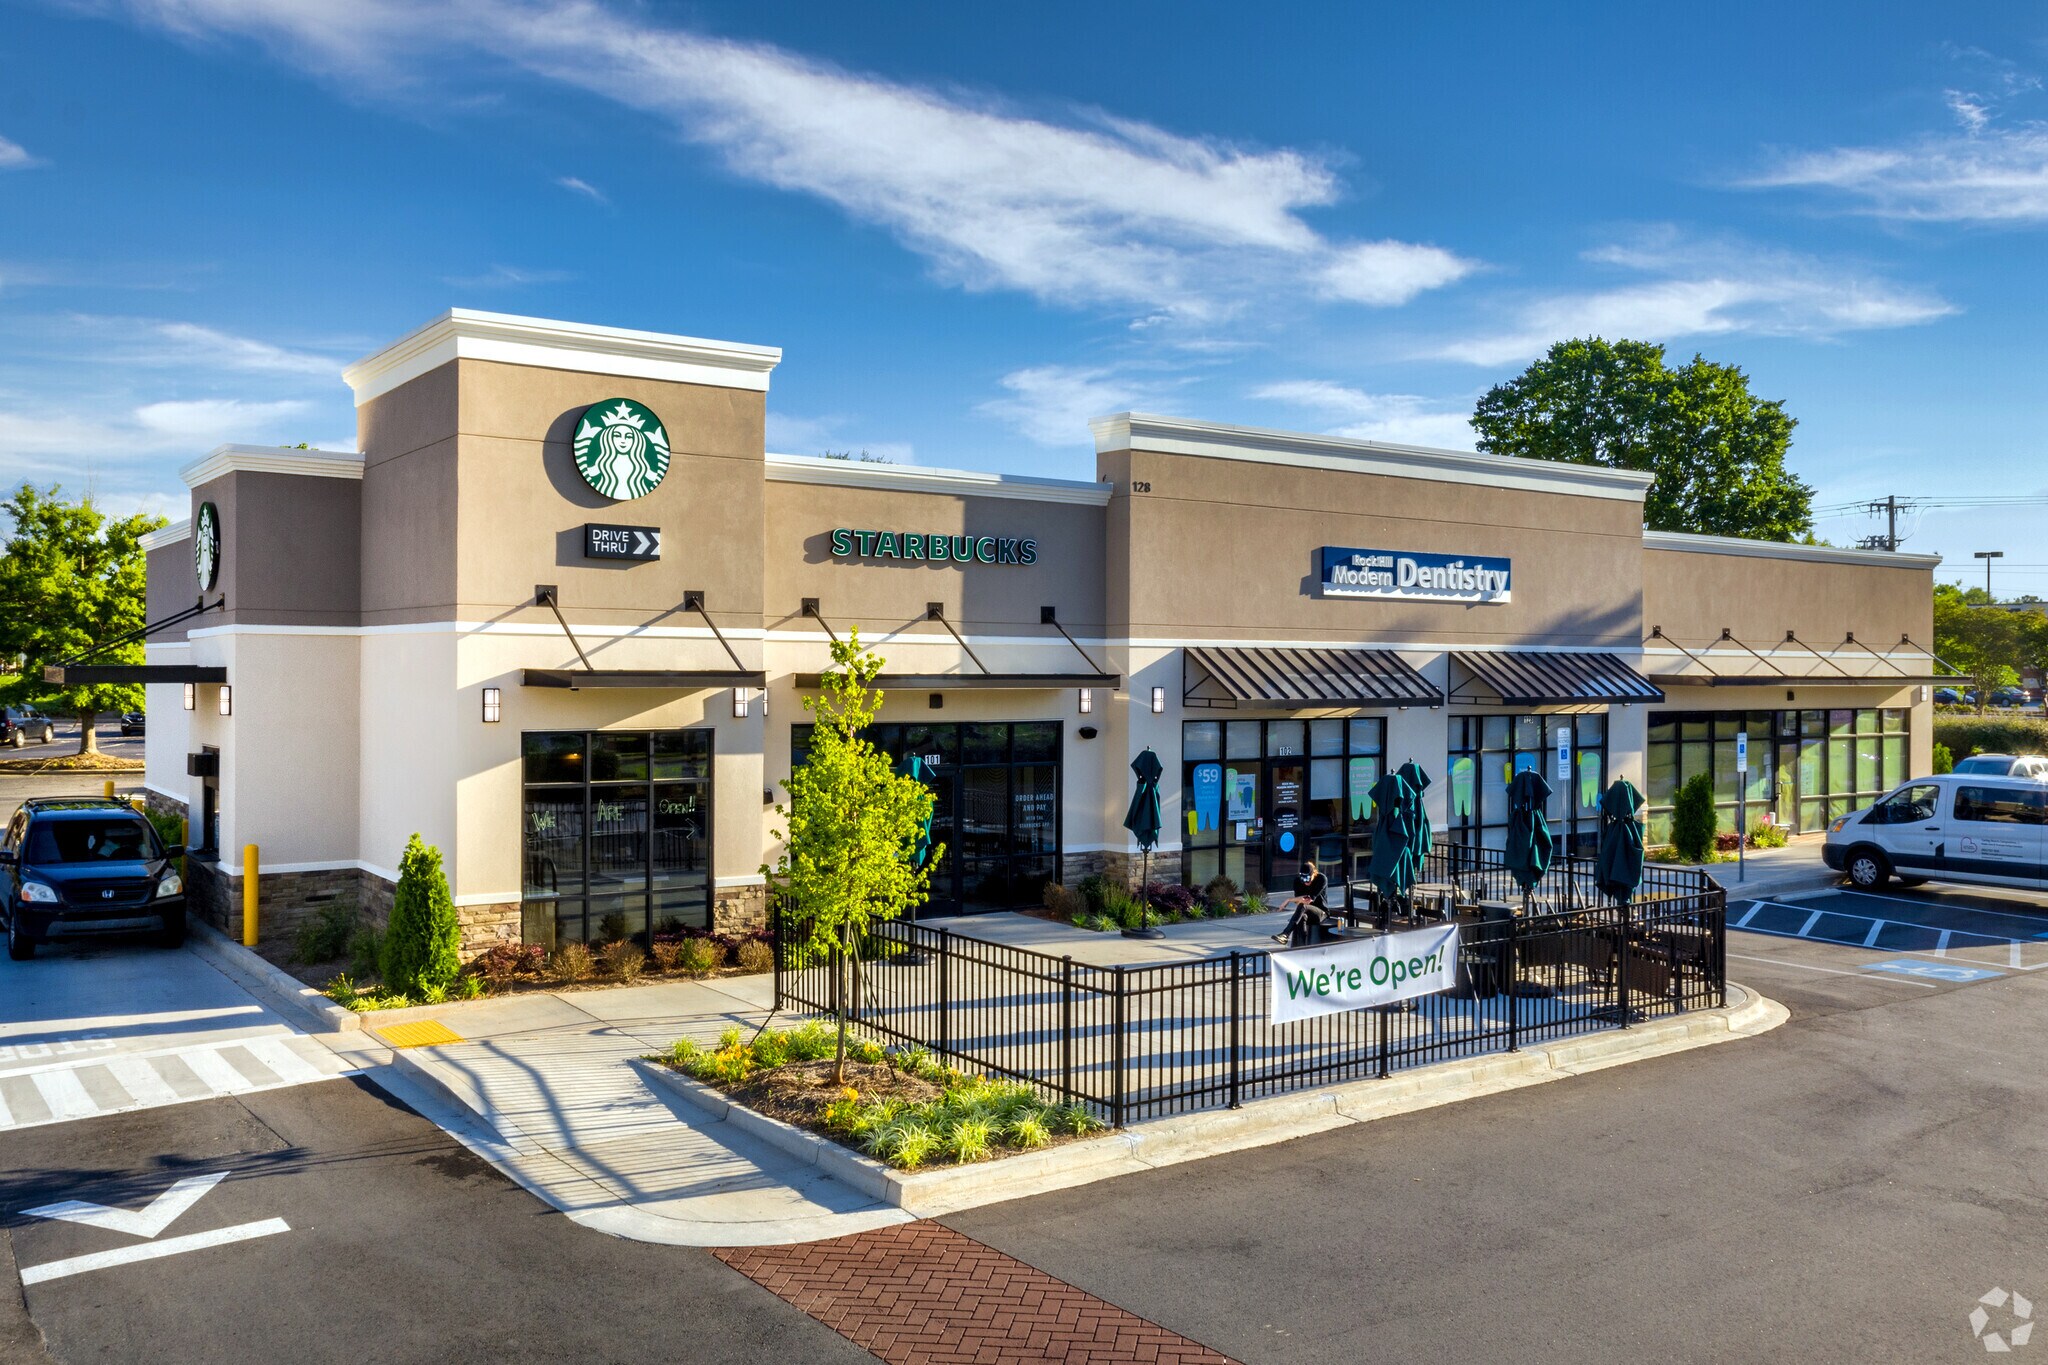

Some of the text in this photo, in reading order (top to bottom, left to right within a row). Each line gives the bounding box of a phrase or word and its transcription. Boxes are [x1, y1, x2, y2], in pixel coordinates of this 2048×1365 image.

[1132, 481, 1151, 493] 128
[592, 529, 630, 542] DRIVE
[592, 541, 627, 554] THRU
[831, 528, 1038, 566] STARBUCKS
[1331, 565, 1395, 586] Modern
[1397, 557, 1509, 598] Dentistry
[1279, 747, 1292, 756] 102
[925, 754, 941, 765] 101
[1198, 768, 1219, 783] $59
[1015, 793, 1054, 802] ORDER AHEAD
[597, 799, 625, 822] ARE
[1036, 803, 1047, 811] PAY
[1286, 944, 1445, 1000] We're Open!
